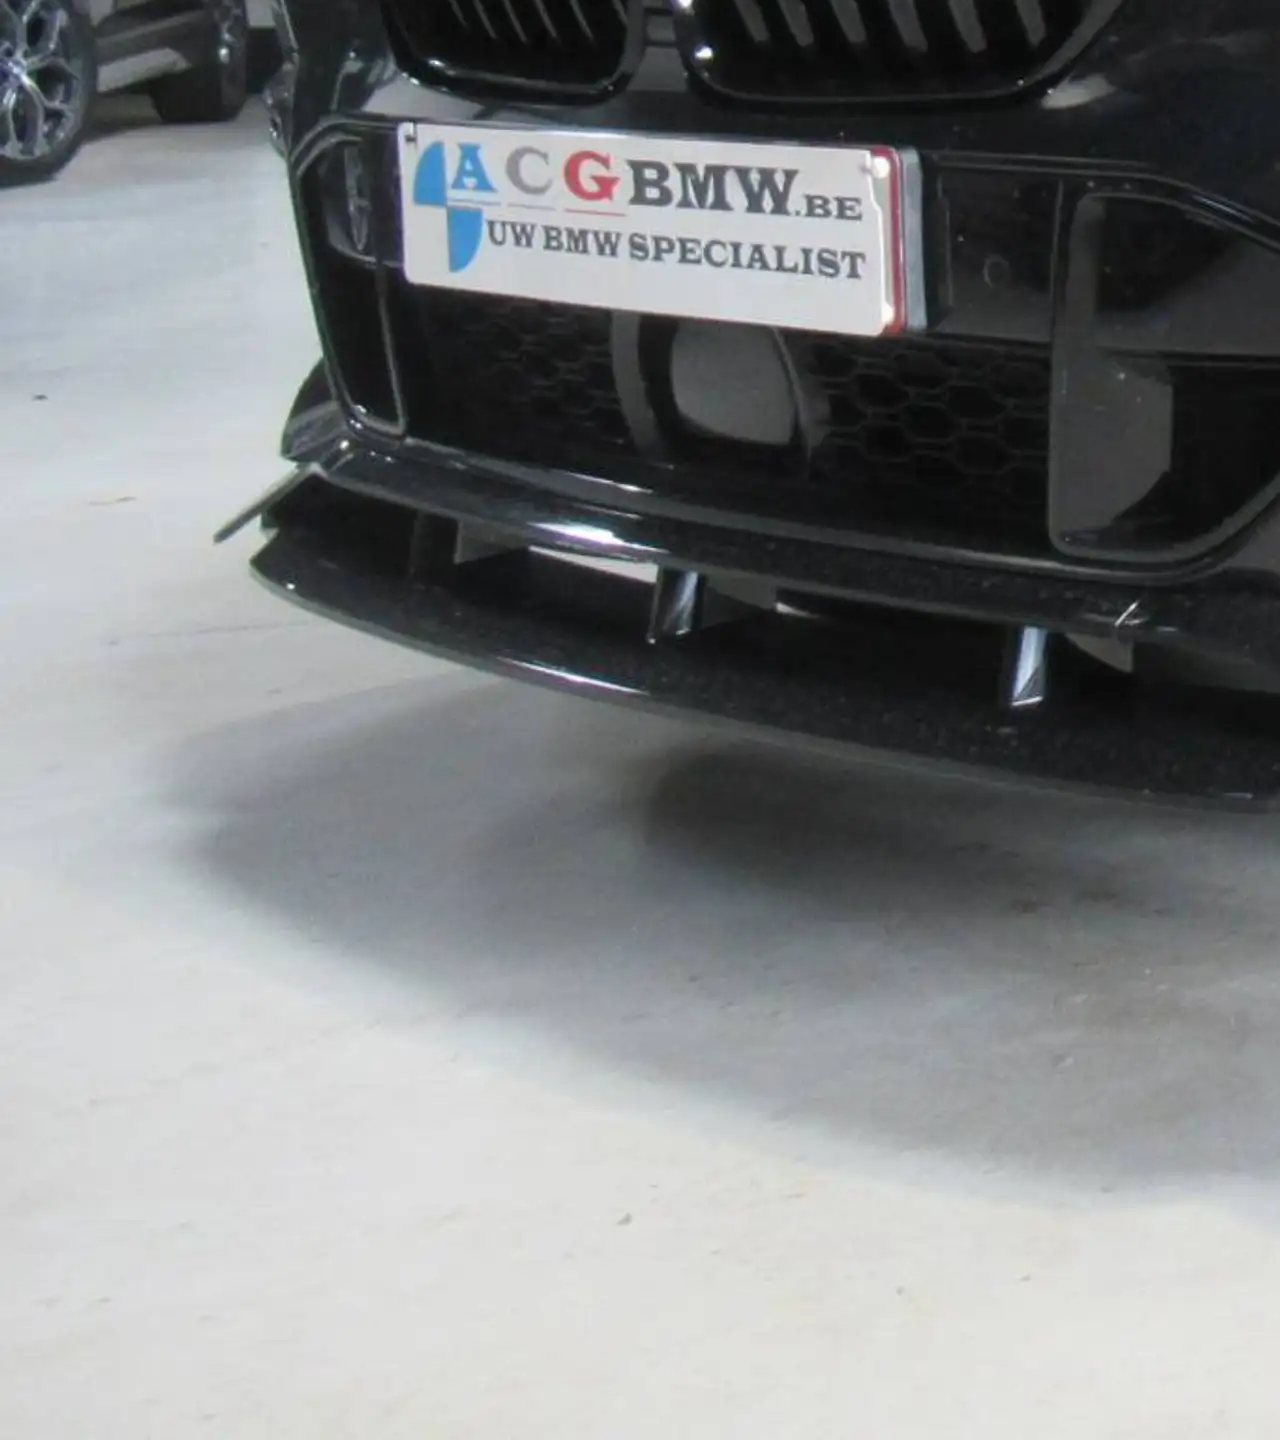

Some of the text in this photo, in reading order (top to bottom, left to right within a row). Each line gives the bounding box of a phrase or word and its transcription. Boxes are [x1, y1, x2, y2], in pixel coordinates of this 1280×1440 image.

[487, 219, 867, 280] UW BMW SPECIALIST
